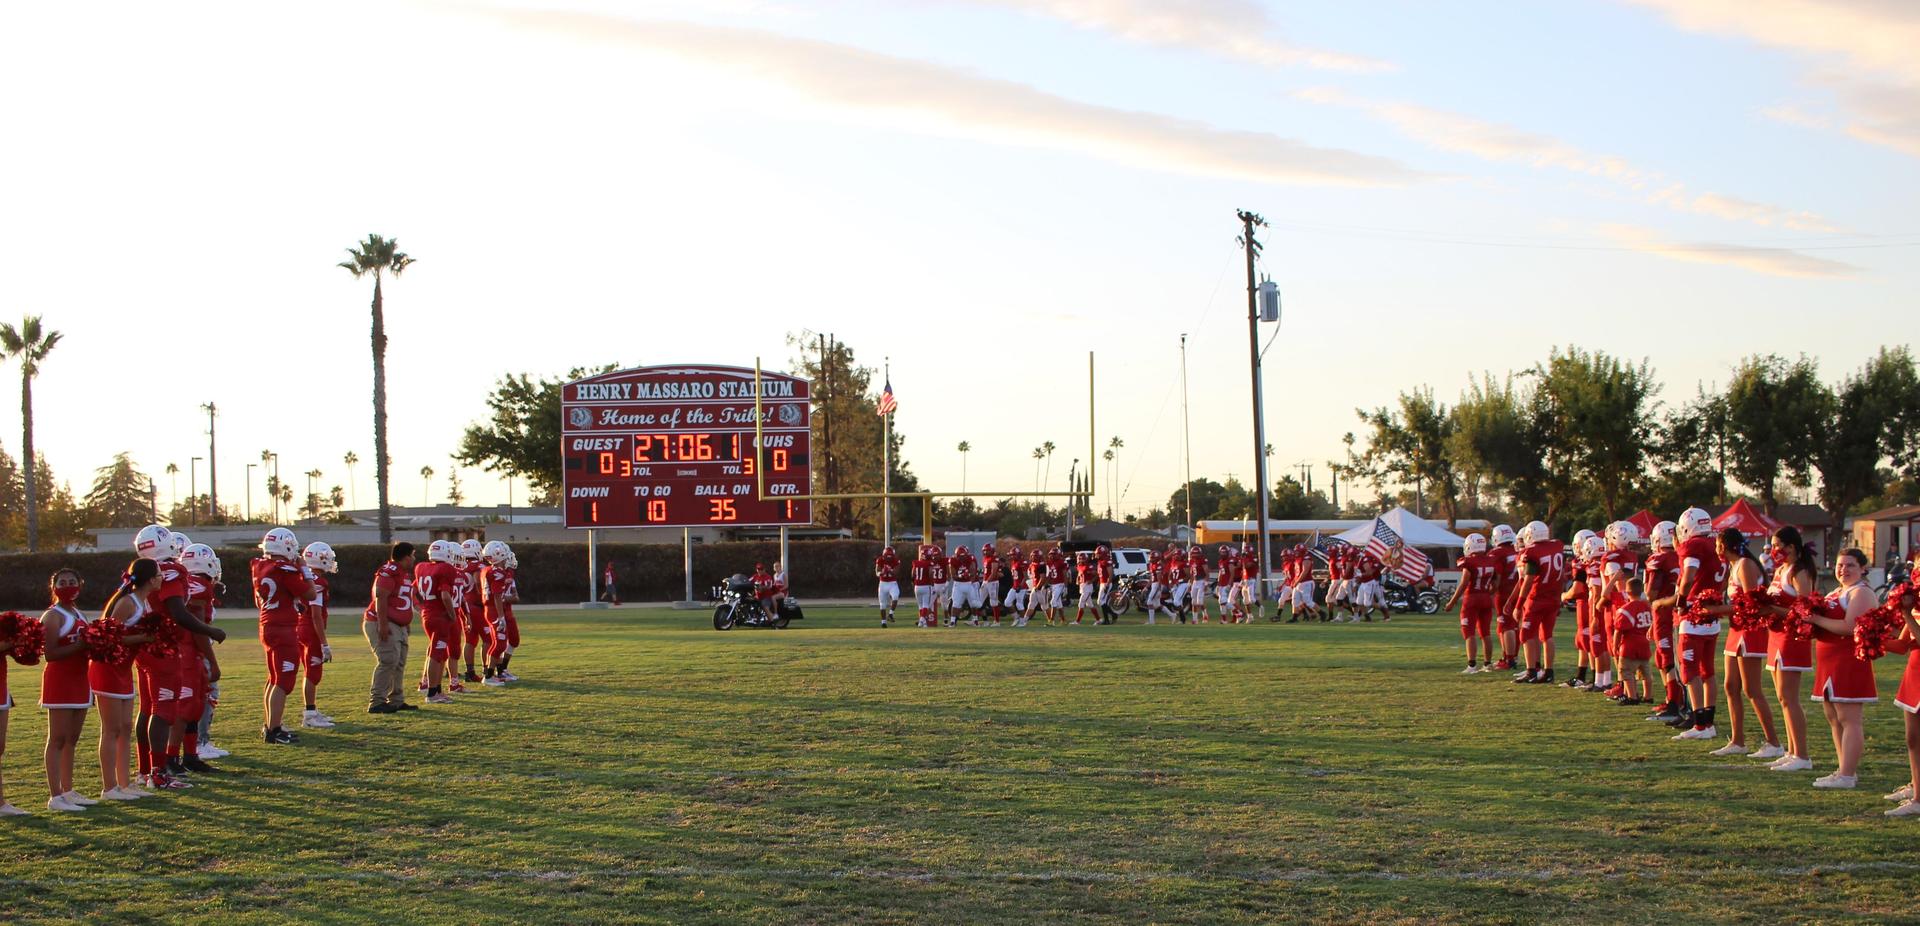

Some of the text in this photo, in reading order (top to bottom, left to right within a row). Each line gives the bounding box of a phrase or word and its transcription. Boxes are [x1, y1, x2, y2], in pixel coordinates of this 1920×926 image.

[576, 383, 632, 400] HENRY
[637, 382, 714, 399] MASSARO
[599, 409, 656, 425] Home
[660, 408, 681, 428] of
[686, 407, 713, 424] the
[573, 438, 624, 451] GUEST
[600, 452, 613, 474] 0
[620, 460, 631, 477] 3
[743, 458, 754, 475] 3
[773, 449, 787, 471] 0
[633, 467, 652, 476] TOL
[723, 465, 741, 475] TOL
[571, 487, 609, 498] DOWN
[633, 485, 671, 497] TO GO
[695, 484, 751, 496] BALL ON
[770, 483, 800, 495] QTR.
[592, 501, 598, 522] 1
[647, 500, 667, 521] 10
[709, 499, 737, 520] 35
[786, 499, 793, 519] 1
[1540, 552, 1564, 584] 79
[1636, 611, 1652, 629] 30
